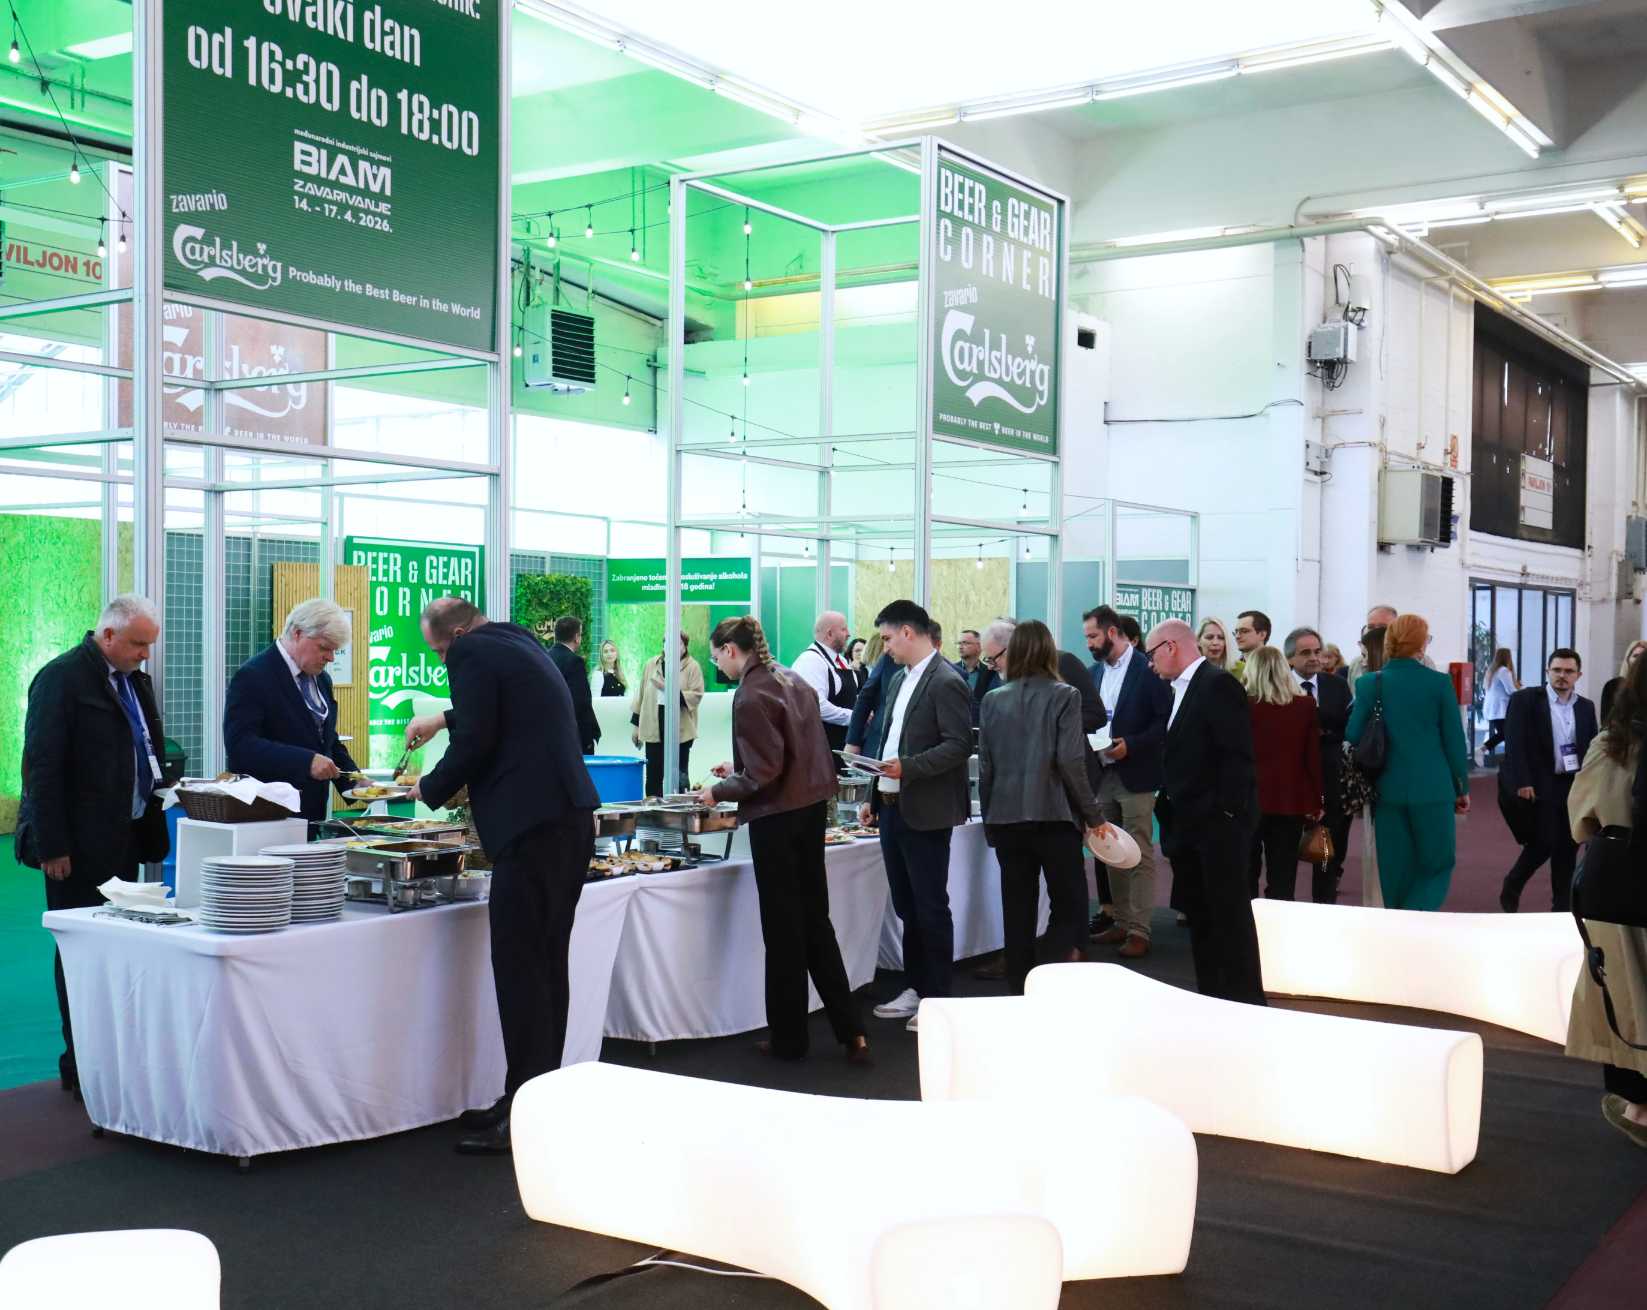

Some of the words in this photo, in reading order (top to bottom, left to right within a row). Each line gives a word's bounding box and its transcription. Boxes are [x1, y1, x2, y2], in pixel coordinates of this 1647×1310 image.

[363, 5, 421, 67] dan
[187, 25, 232, 78] od
[243, 35, 340, 112] 16:30
[350, 74, 388, 127] do
[397, 88, 479, 157] 18:00
[294, 140, 391, 196] BIAM
[169, 189, 228, 213] zavario
[293, 179, 391, 215] ZAVARIVANJE
[293, 195, 312, 212] 14.
[324, 203, 341, 219] 17.
[344, 209, 356, 223] 4.
[359, 213, 393, 233] 2026.
[940, 167, 986, 228] BEER
[992, 200, 1001, 232] &
[1007, 197, 1050, 252] GEAR
[173, 223, 282, 286] Carlsberg
[940, 217, 1049, 301] CORNER
[164, 303, 193, 321] ario
[288, 266, 342, 292] Probably
[344, 279, 363, 295] the
[365, 283, 389, 300] Best
[392, 290, 417, 306] Beer
[419, 295, 430, 309] in
[432, 298, 449, 313] the
[451, 303, 481, 320] World
[941, 309, 1050, 406] Carlsberg
[408, 560, 418, 584] &
[425, 555, 472, 586] GEAR
[1141, 588, 1162, 610] BEER
[1171, 590, 1192, 612] GEAR
[369, 624, 394, 644] ario
